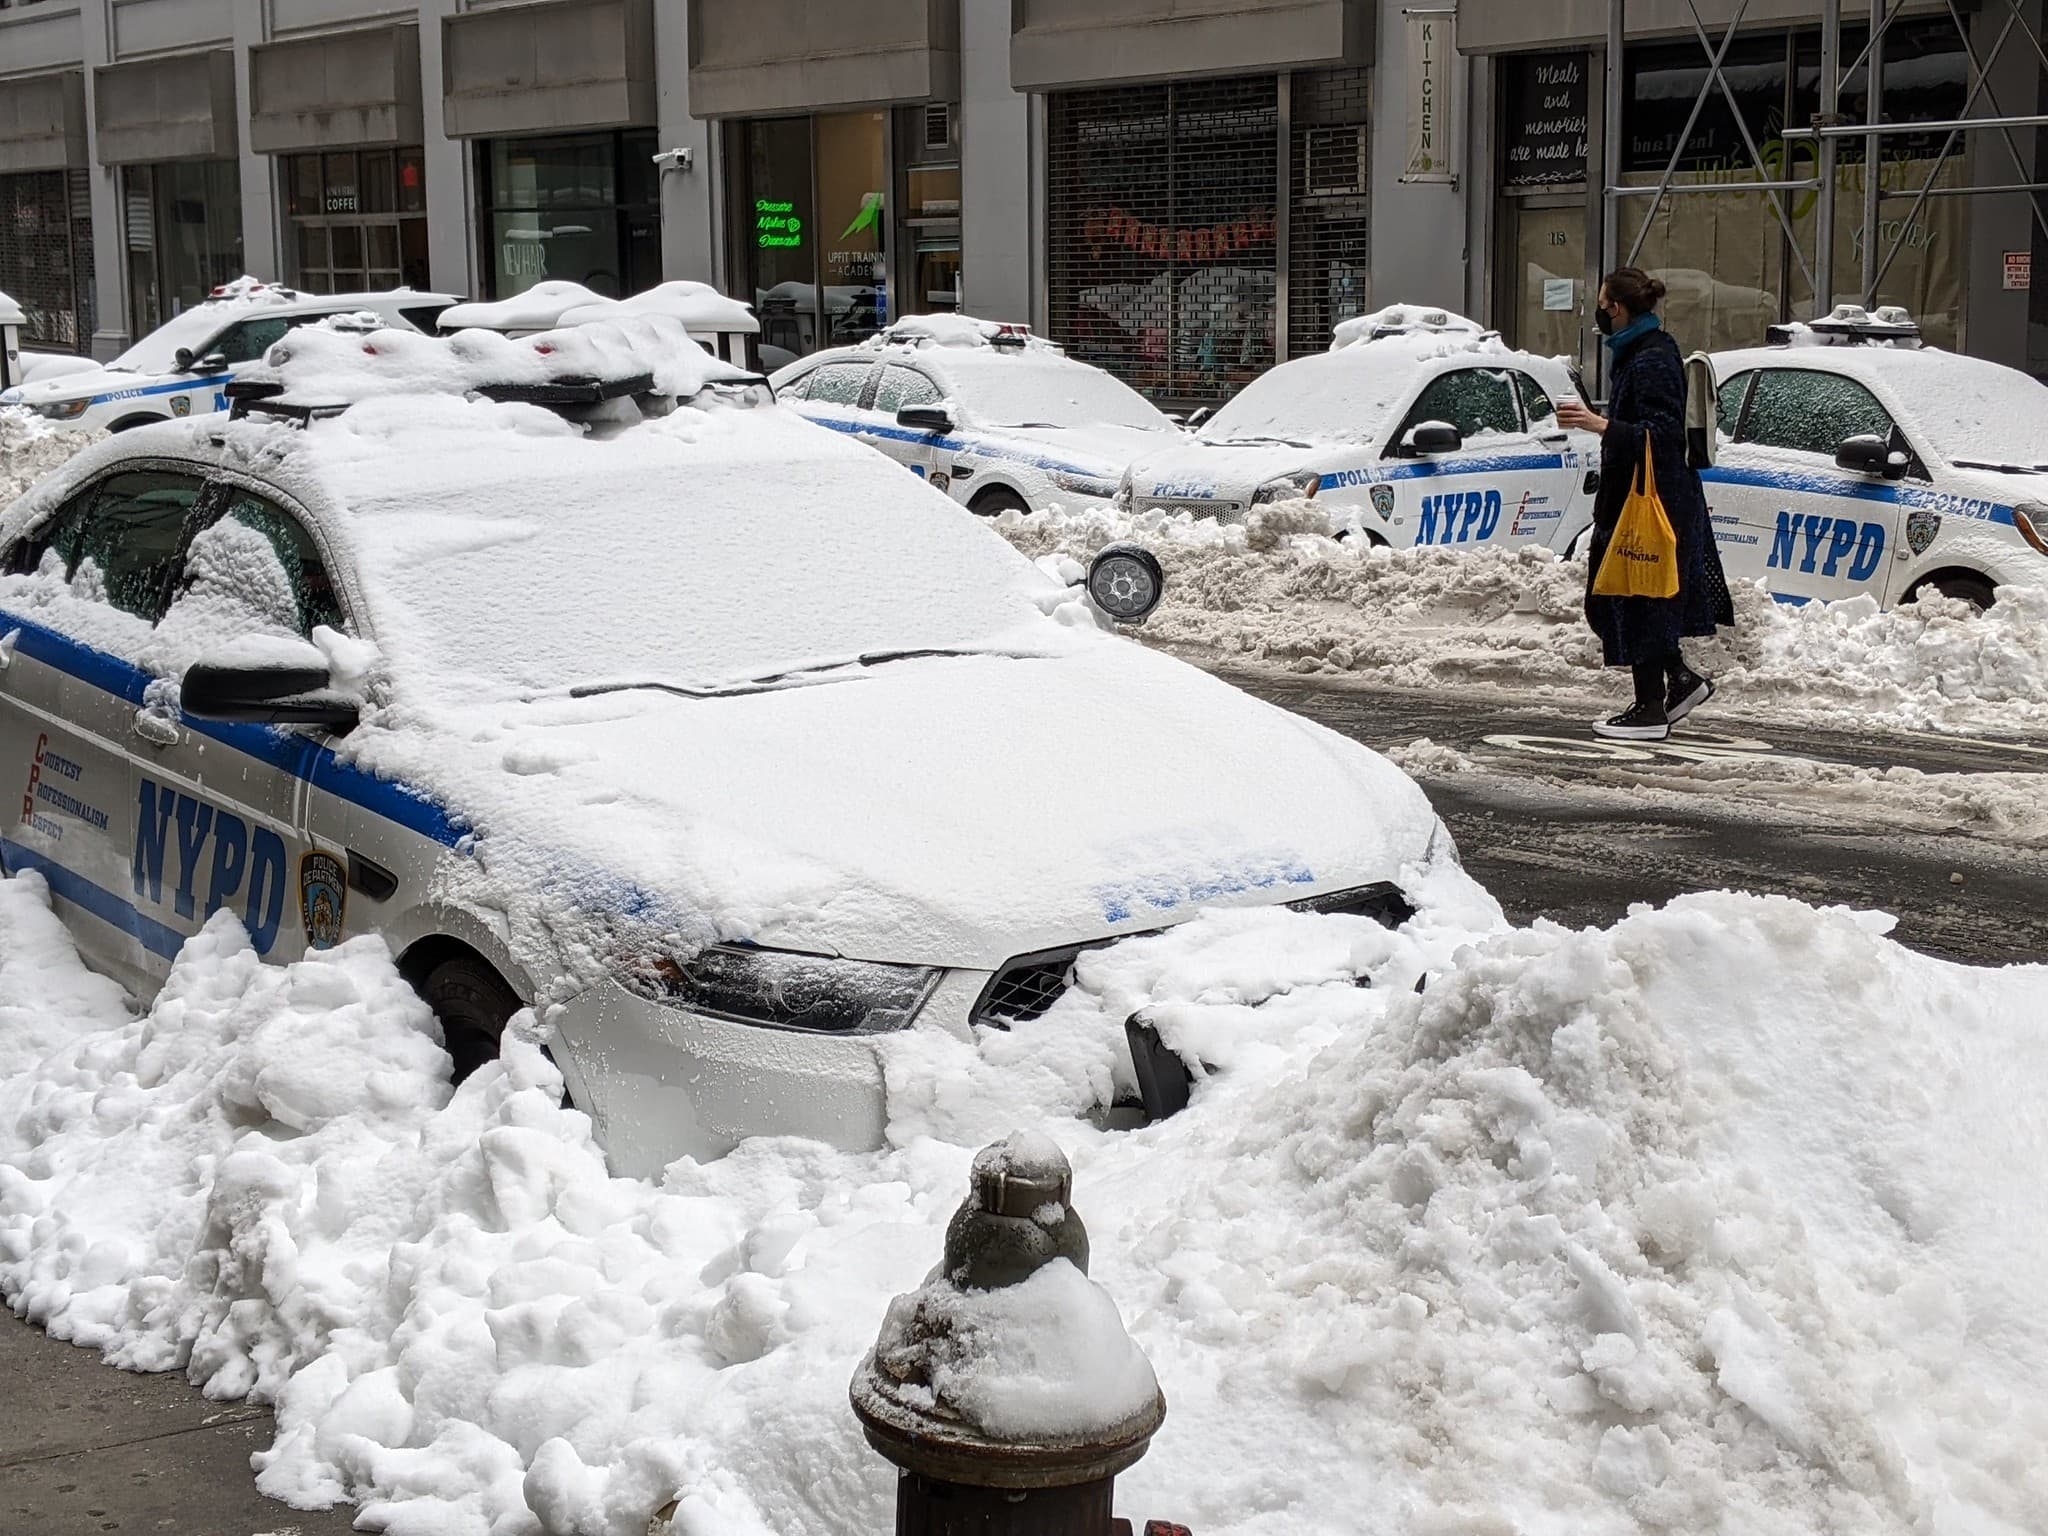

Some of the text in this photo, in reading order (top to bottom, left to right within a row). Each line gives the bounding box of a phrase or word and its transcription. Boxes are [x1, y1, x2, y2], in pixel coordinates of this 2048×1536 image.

[1536, 61, 1579, 84] Meals
[1422, 24, 1432, 149] KITCHEN
[1543, 91, 1570, 109] and
[1525, 116, 1587, 135] memories
[1510, 145, 1531, 161] are
[1536, 141, 1569, 159] made
[1851, 219, 1937, 263] KTCHEN
[827, 250, 849, 264] UPFIT
[106, 389, 143, 401] POLICE
[1416, 489, 1501, 547] NYPD
[1926, 489, 1991, 520] POLICE
[1766, 511, 1885, 581] NYPD
[134, 778, 287, 956] NYPD
[313, 856, 338, 878] POLICE
[303, 869, 343, 900] DEPARTMENT
